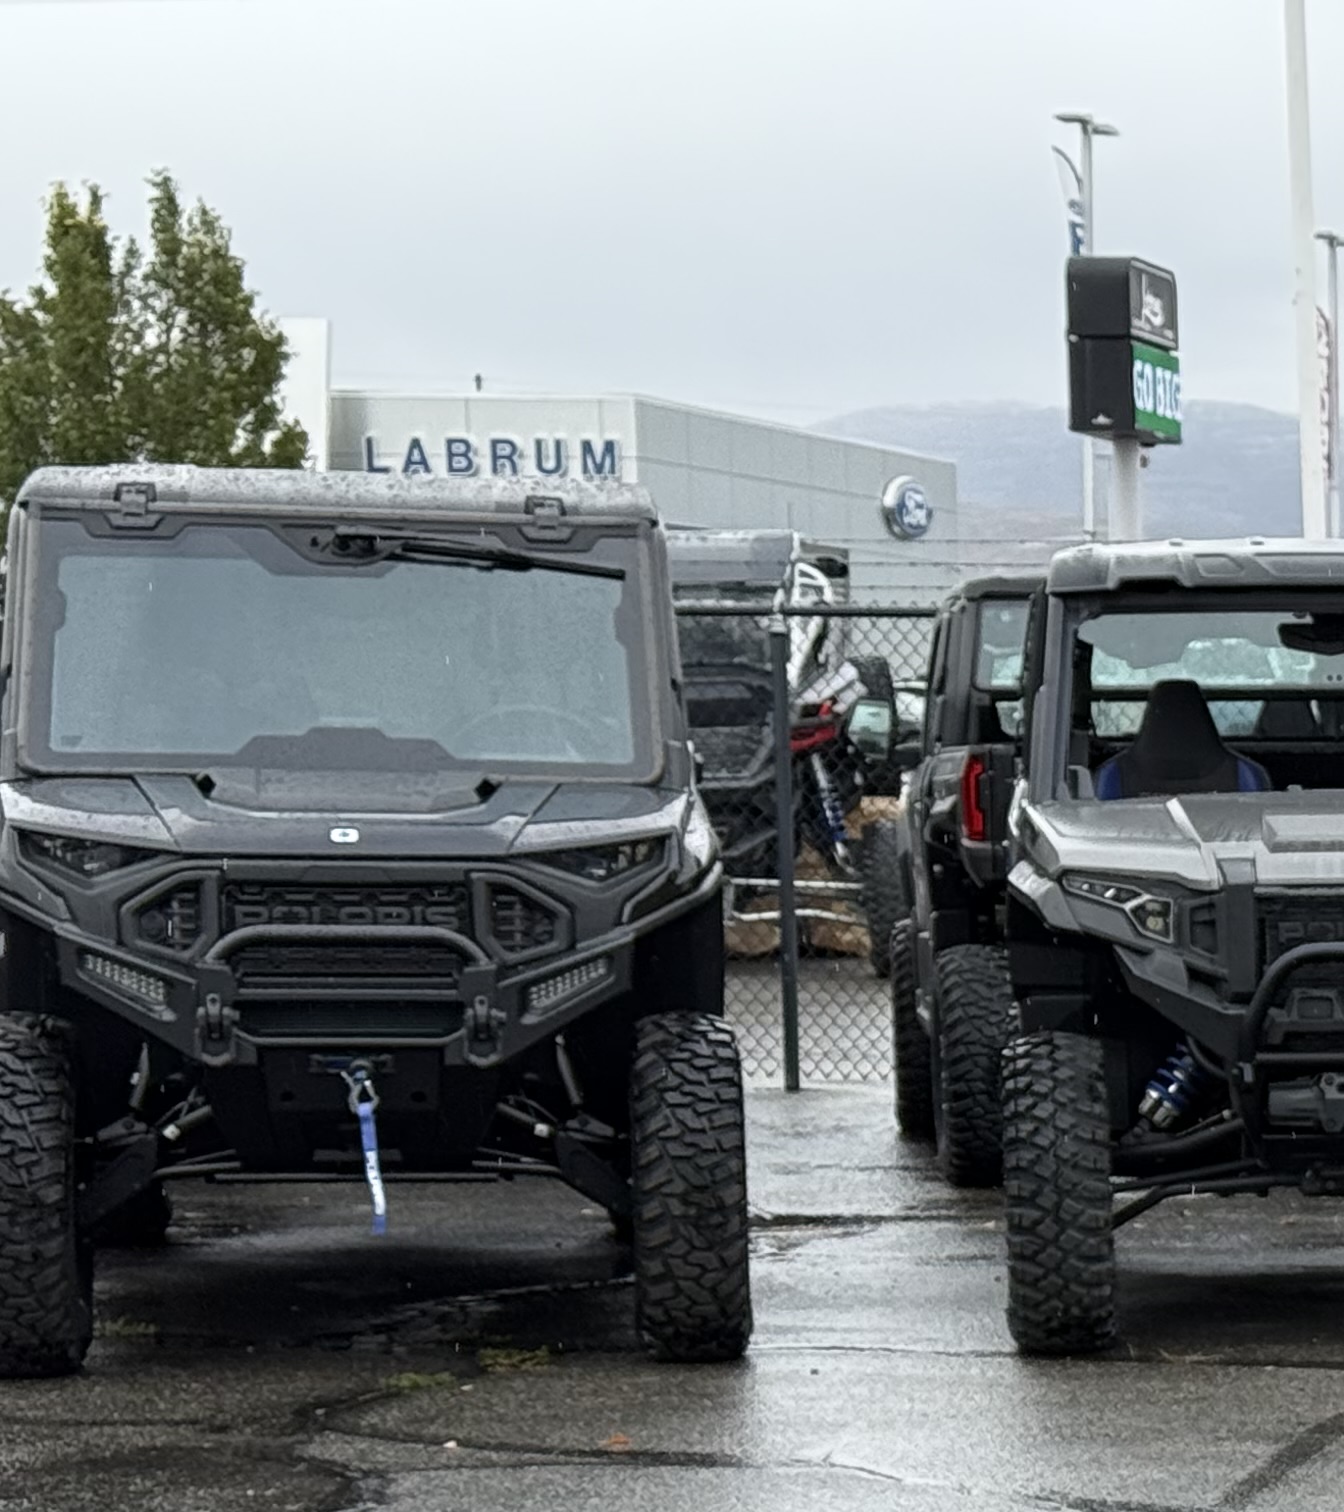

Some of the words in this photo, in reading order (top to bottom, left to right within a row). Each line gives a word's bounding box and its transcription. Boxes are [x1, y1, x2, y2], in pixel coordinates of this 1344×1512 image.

[1133, 359, 1154, 413] GO
[1155, 366, 1182, 420] BIG
[365, 436, 617, 475] LABRUM
